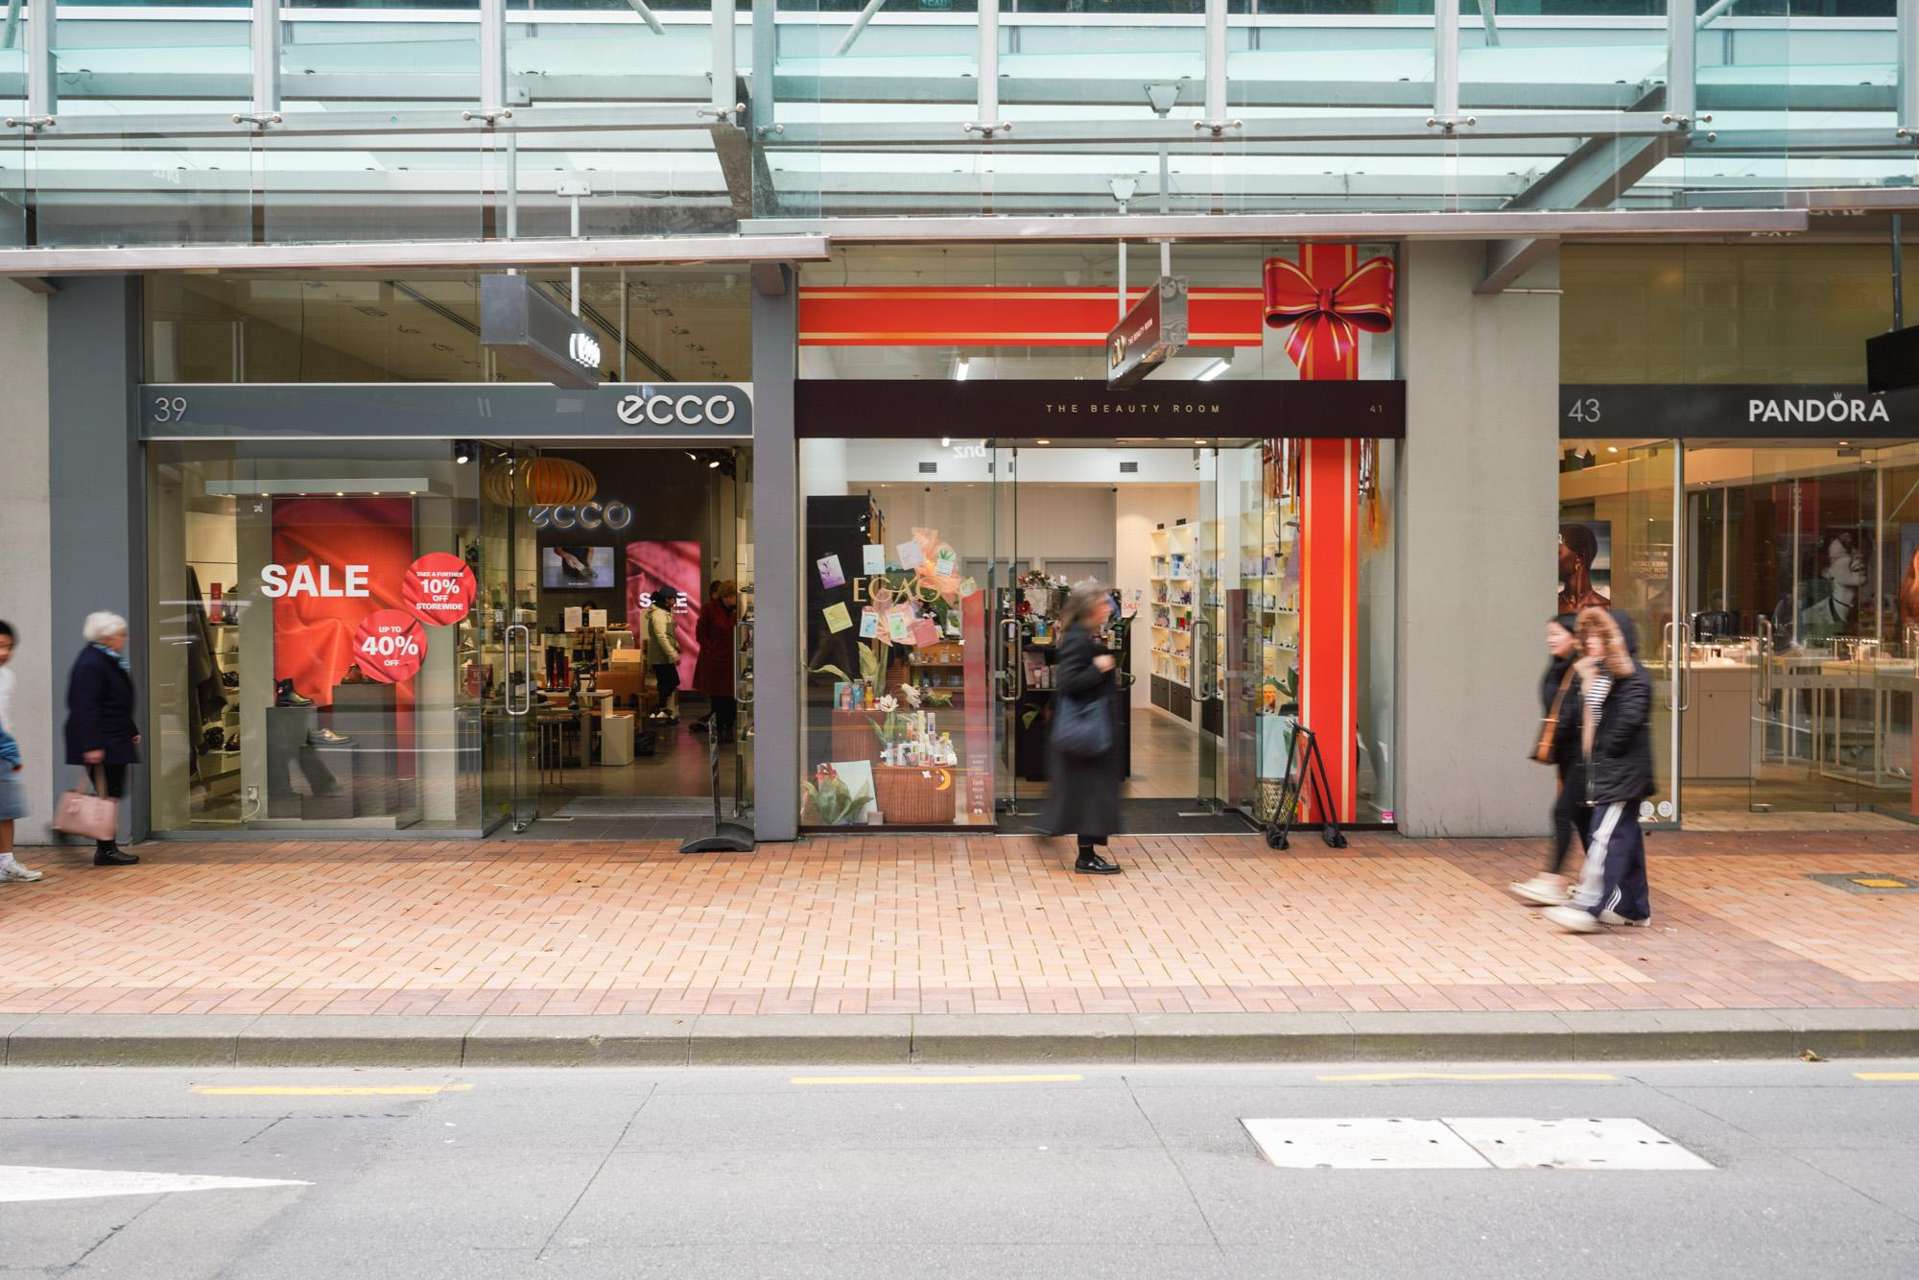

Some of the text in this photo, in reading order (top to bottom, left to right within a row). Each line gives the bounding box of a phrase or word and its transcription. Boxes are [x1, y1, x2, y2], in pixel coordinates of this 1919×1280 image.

[154, 397, 187, 421] 39
[617, 394, 735, 424] ecco
[1046, 404, 1220, 413] THE BEAUTY ROOM
[1369, 404, 1383, 413] 41
[1568, 399, 1600, 422] 43
[1749, 398, 1890, 421] PANDORA
[528, 501, 632, 529] ecco
[261, 564, 369, 598] SALE
[420, 579, 460, 594] 10%
[639, 592, 688, 608] SE
[361, 635, 419, 656] 40%
